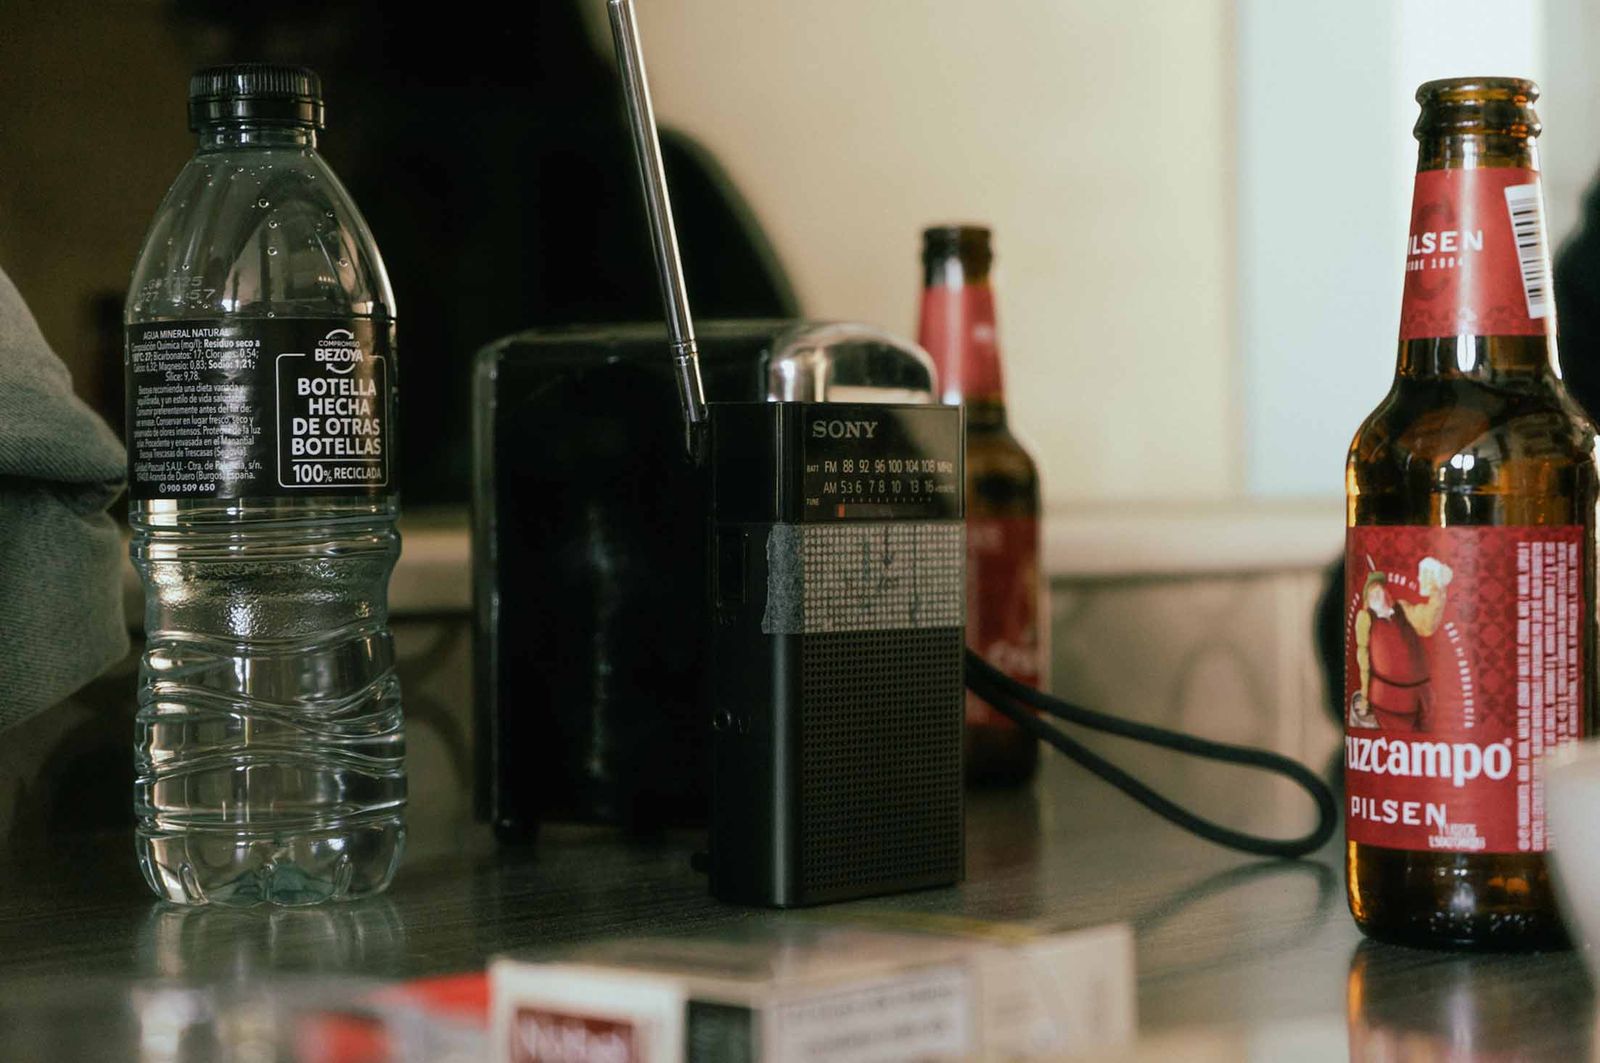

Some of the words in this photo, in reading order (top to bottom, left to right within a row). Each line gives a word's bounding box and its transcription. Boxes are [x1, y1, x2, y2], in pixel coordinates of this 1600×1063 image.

[143, 330, 159, 340] AGUA
[160, 329, 191, 339] MINERAL
[204, 338, 235, 348] Residuo
[236, 340, 254, 348] seco
[193, 349, 204, 360] 17;
[240, 348, 259, 360] 0,54;
[314, 348, 364, 362] BEZOYA
[190, 360, 207, 371] 0,83;
[208, 359, 233, 369] Sodio:
[235, 359, 255, 370] 1,21;
[184, 371, 200, 382] 9,78.
[196, 382, 212, 392] dieta
[297, 377, 377, 396] BOTELLA
[189, 394, 198, 402] de
[199, 392, 212, 402] vida
[199, 405, 216, 413] antes
[309, 398, 371, 415] HECHA
[192, 415, 208, 428] lugar
[292, 417, 321, 435] DE
[325, 417, 381, 436] OTRAS
[812, 420, 878, 438] SONY
[185, 447, 213, 457] Trescasas
[291, 437, 382, 456] BOTELLAS
[204, 460, 214, 470] de
[807, 464, 819, 472] BATT
[824, 461, 837, 473] FM
[842, 460, 854, 473] 88
[859, 460, 870, 473] 92
[875, 460, 886, 473] 96
[888, 460, 903, 473] 100
[905, 460, 919, 473] 104
[292, 464, 333, 483] 100%
[334, 466, 382, 479] RECICLADA
[167, 484, 181, 492] 900
[182, 483, 197, 492] 509
[199, 483, 215, 491] 650
[823, 481, 837, 494] AM
[855, 480, 862, 494] 6
[869, 480, 875, 494] 7
[878, 480, 885, 494] 8
[891, 480, 901, 494] 10
[909, 480, 919, 494] 13
[924, 480, 934, 494] 16
[1351, 795, 1446, 829] PILSEN
